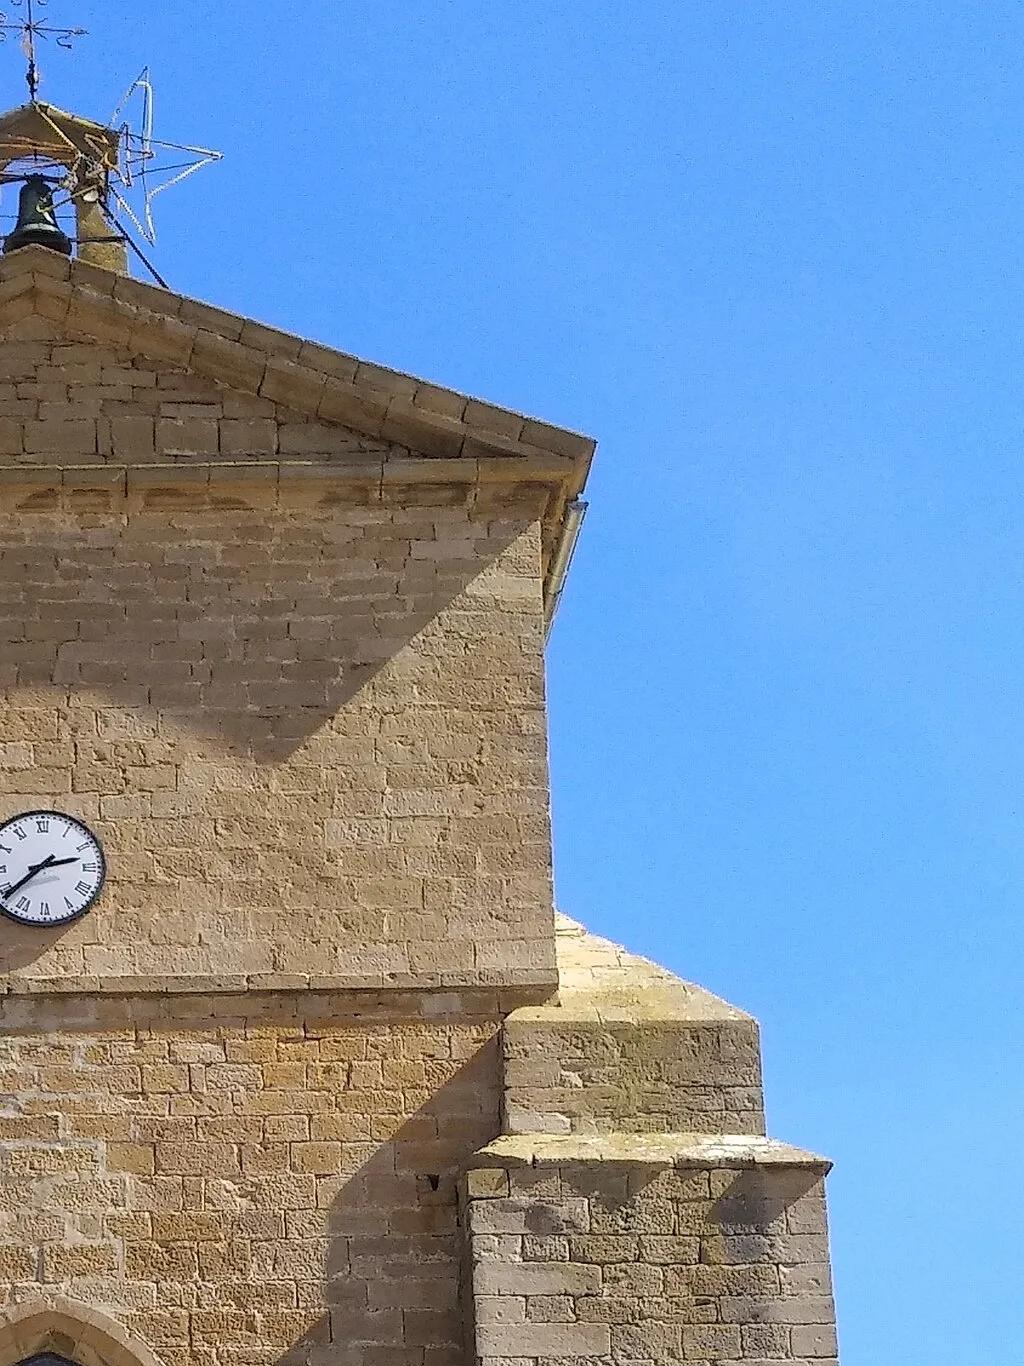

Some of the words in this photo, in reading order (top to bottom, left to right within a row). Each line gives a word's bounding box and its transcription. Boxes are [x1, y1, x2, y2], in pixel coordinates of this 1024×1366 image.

[14, 826, 27, 840] XI
[36, 821, 49, 833] XII
[62, 827, 70, 838] I
[76, 842, 89, 852] II
[82, 863, 96, 872] III
[16, 896, 31, 912] VII
[40, 902, 50, 915] VI
[64, 896, 73, 909] V
